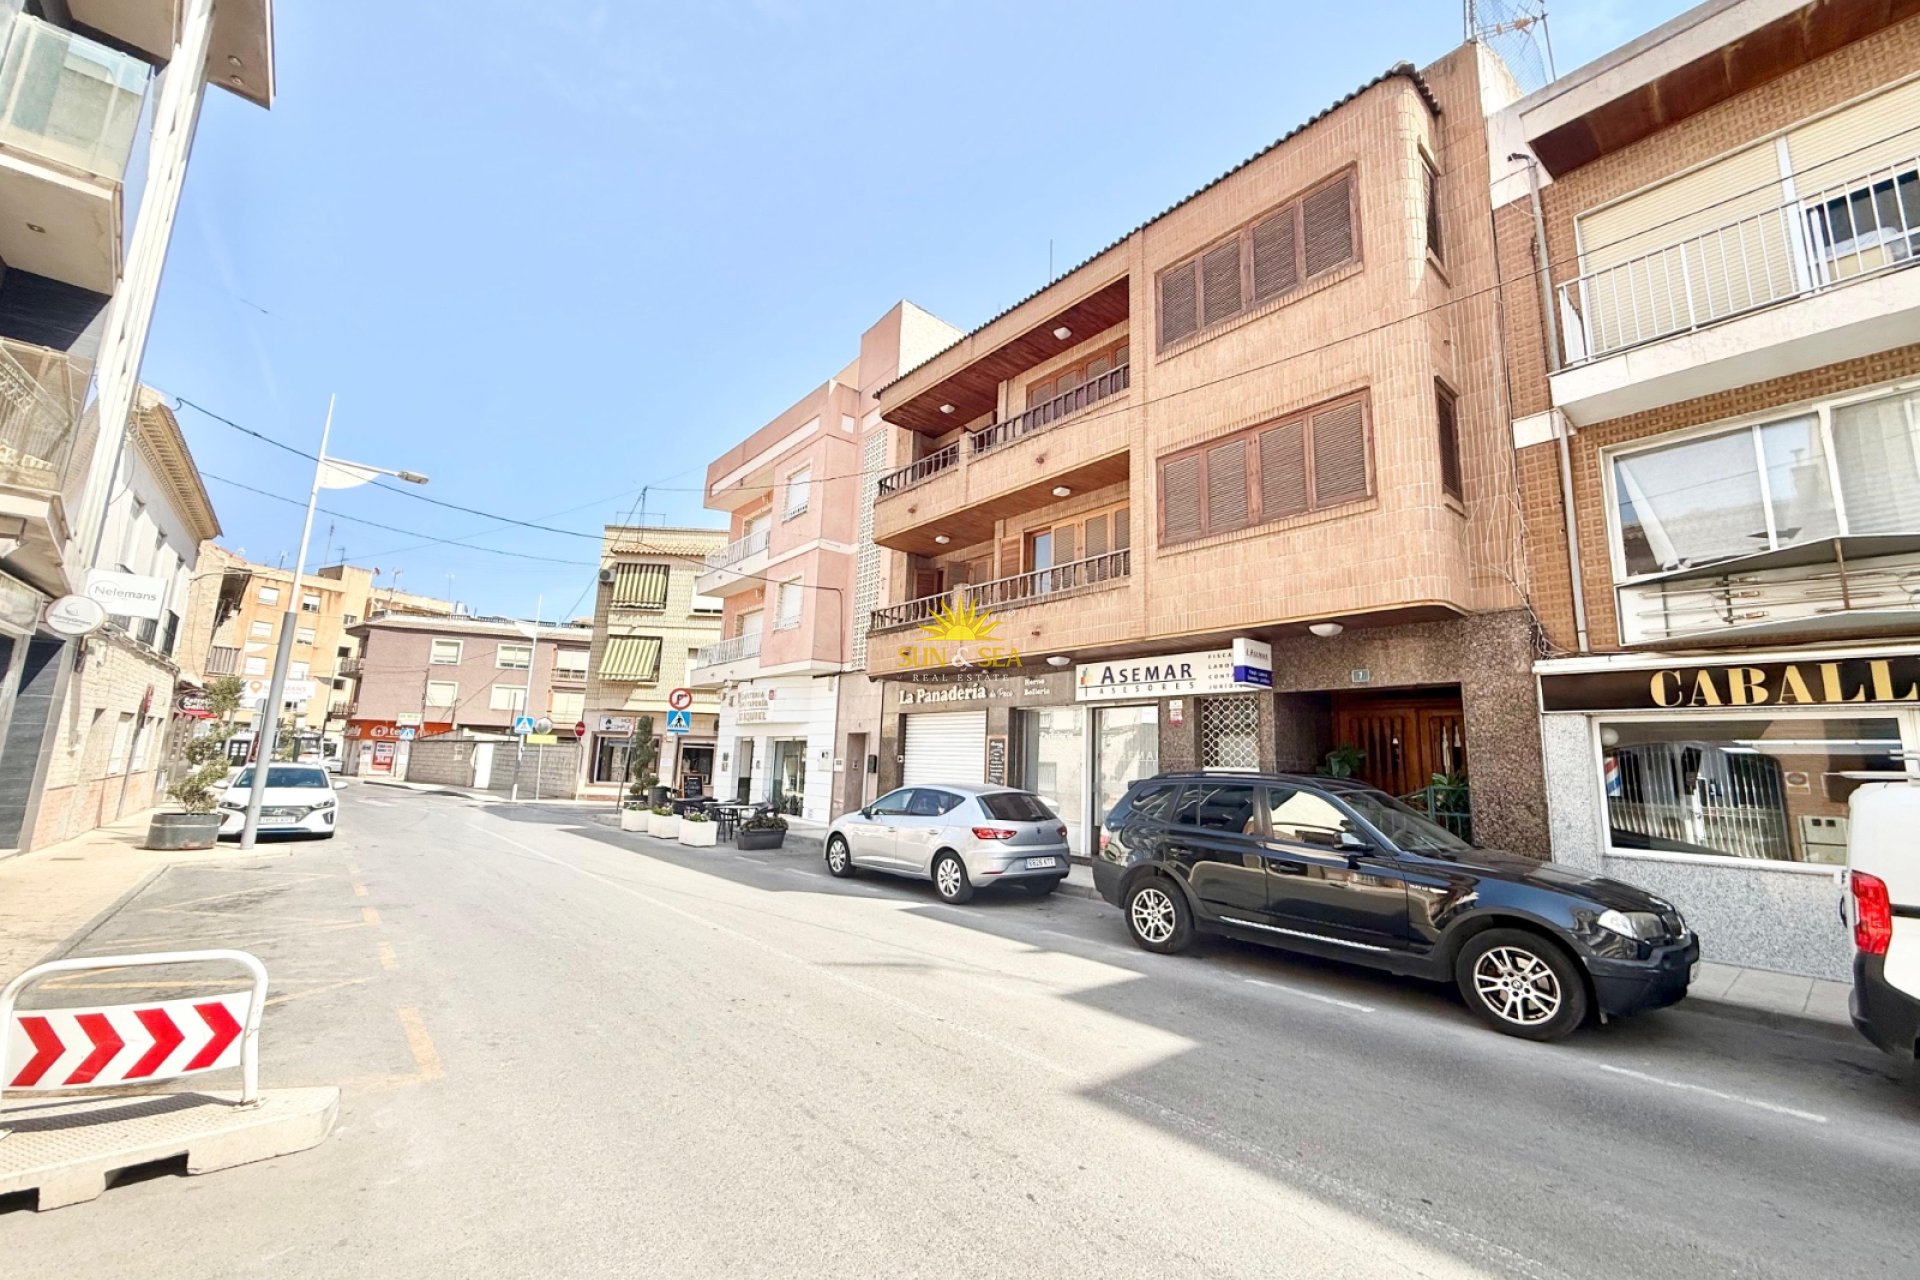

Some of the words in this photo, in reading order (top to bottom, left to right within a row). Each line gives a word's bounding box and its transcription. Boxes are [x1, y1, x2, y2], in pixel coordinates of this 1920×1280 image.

[94, 585, 157, 601] Nelemans
[1207, 651, 1233, 660] FISCA
[1099, 681, 1195, 695] ASESORES
[1650, 659, 1920, 708] CABALL
[899, 689, 914, 704] La
[916, 682, 987, 703] Panadería
